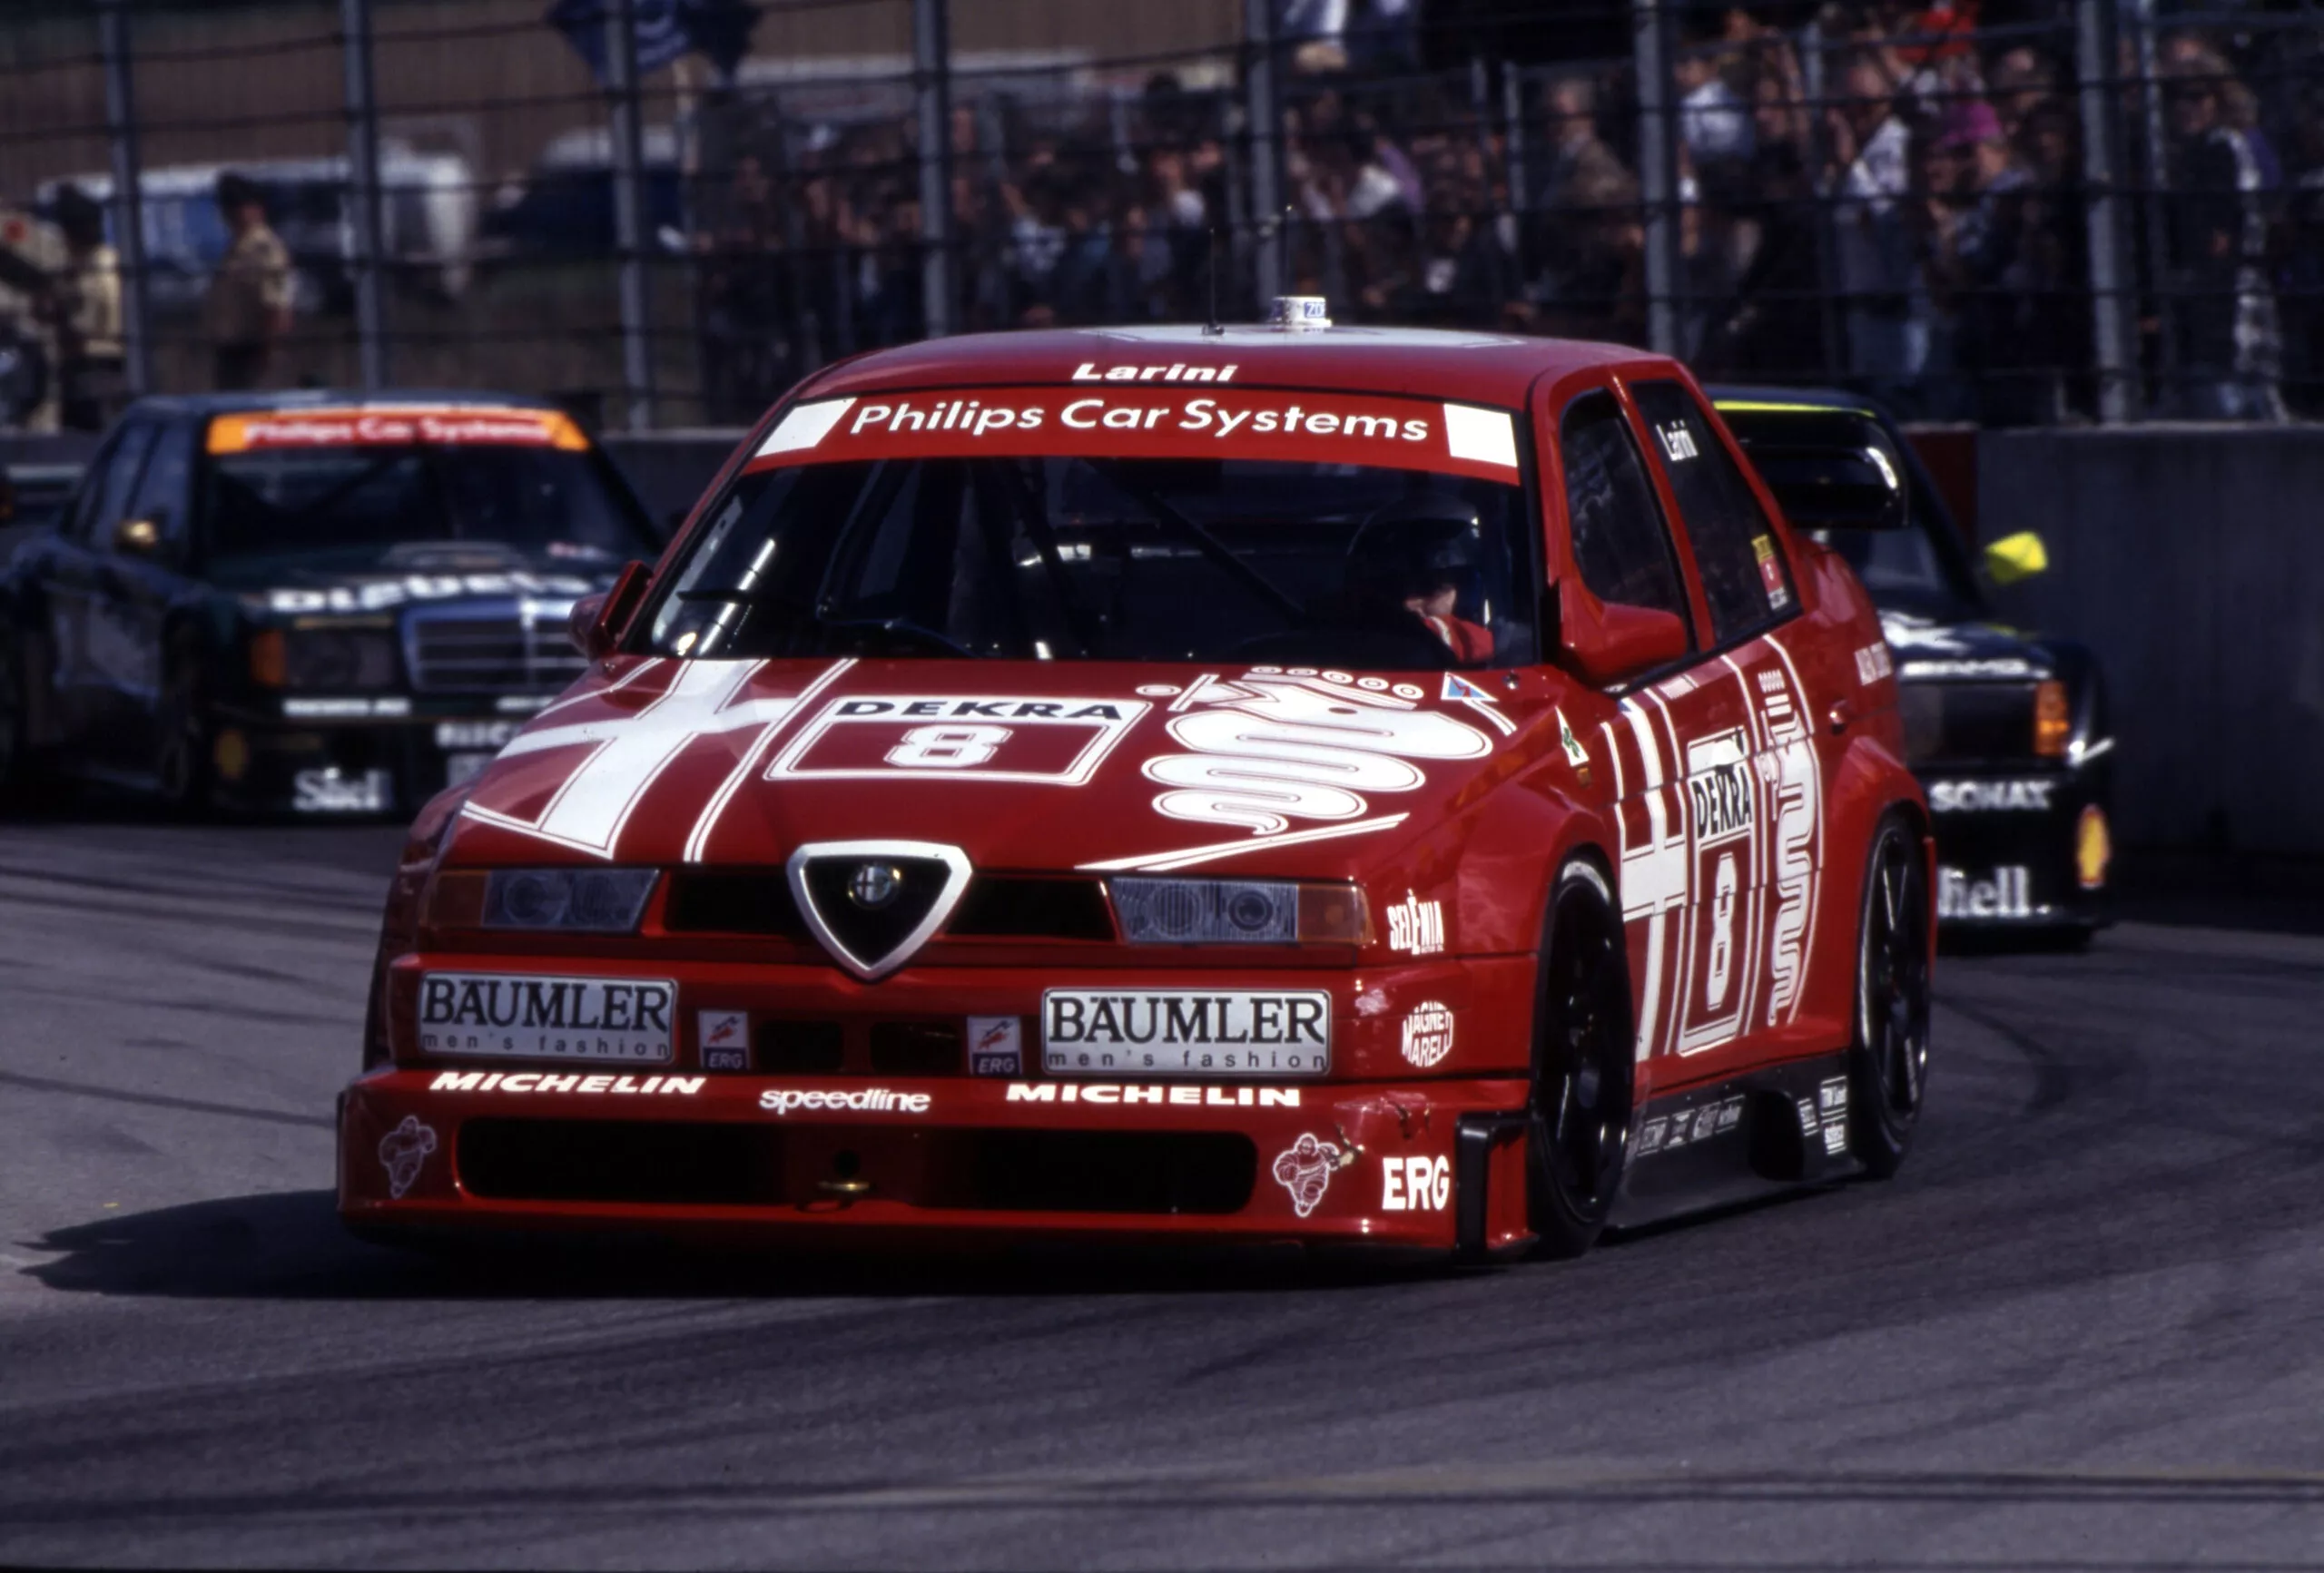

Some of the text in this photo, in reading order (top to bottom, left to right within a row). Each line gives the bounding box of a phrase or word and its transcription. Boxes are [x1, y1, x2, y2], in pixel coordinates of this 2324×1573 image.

[1072, 363, 1238, 381] Larini
[850, 398, 1428, 441] Philips Car Systems
[835, 701, 1122, 721] DEKRA
[882, 725, 1014, 768] 8
[1691, 765, 1753, 839] DEKRA
[1936, 866, 2033, 917] hell
[1387, 888, 1444, 955] SELENIA
[1708, 851, 1738, 1012] 8
[422, 978, 668, 1033] BÄUMLER
[1049, 997, 1324, 1044] BÄUMLER
[422, 1031, 669, 1056] men's fashion
[979, 1057, 1015, 1073] ERG
[1047, 1049, 1325, 1067] men's fashion
[429, 1071, 706, 1095] MICHELIN
[759, 1087, 931, 1116] speedline
[1006, 1083, 1301, 1107] MICHELIN
[1382, 1154, 1450, 1212] ERG
